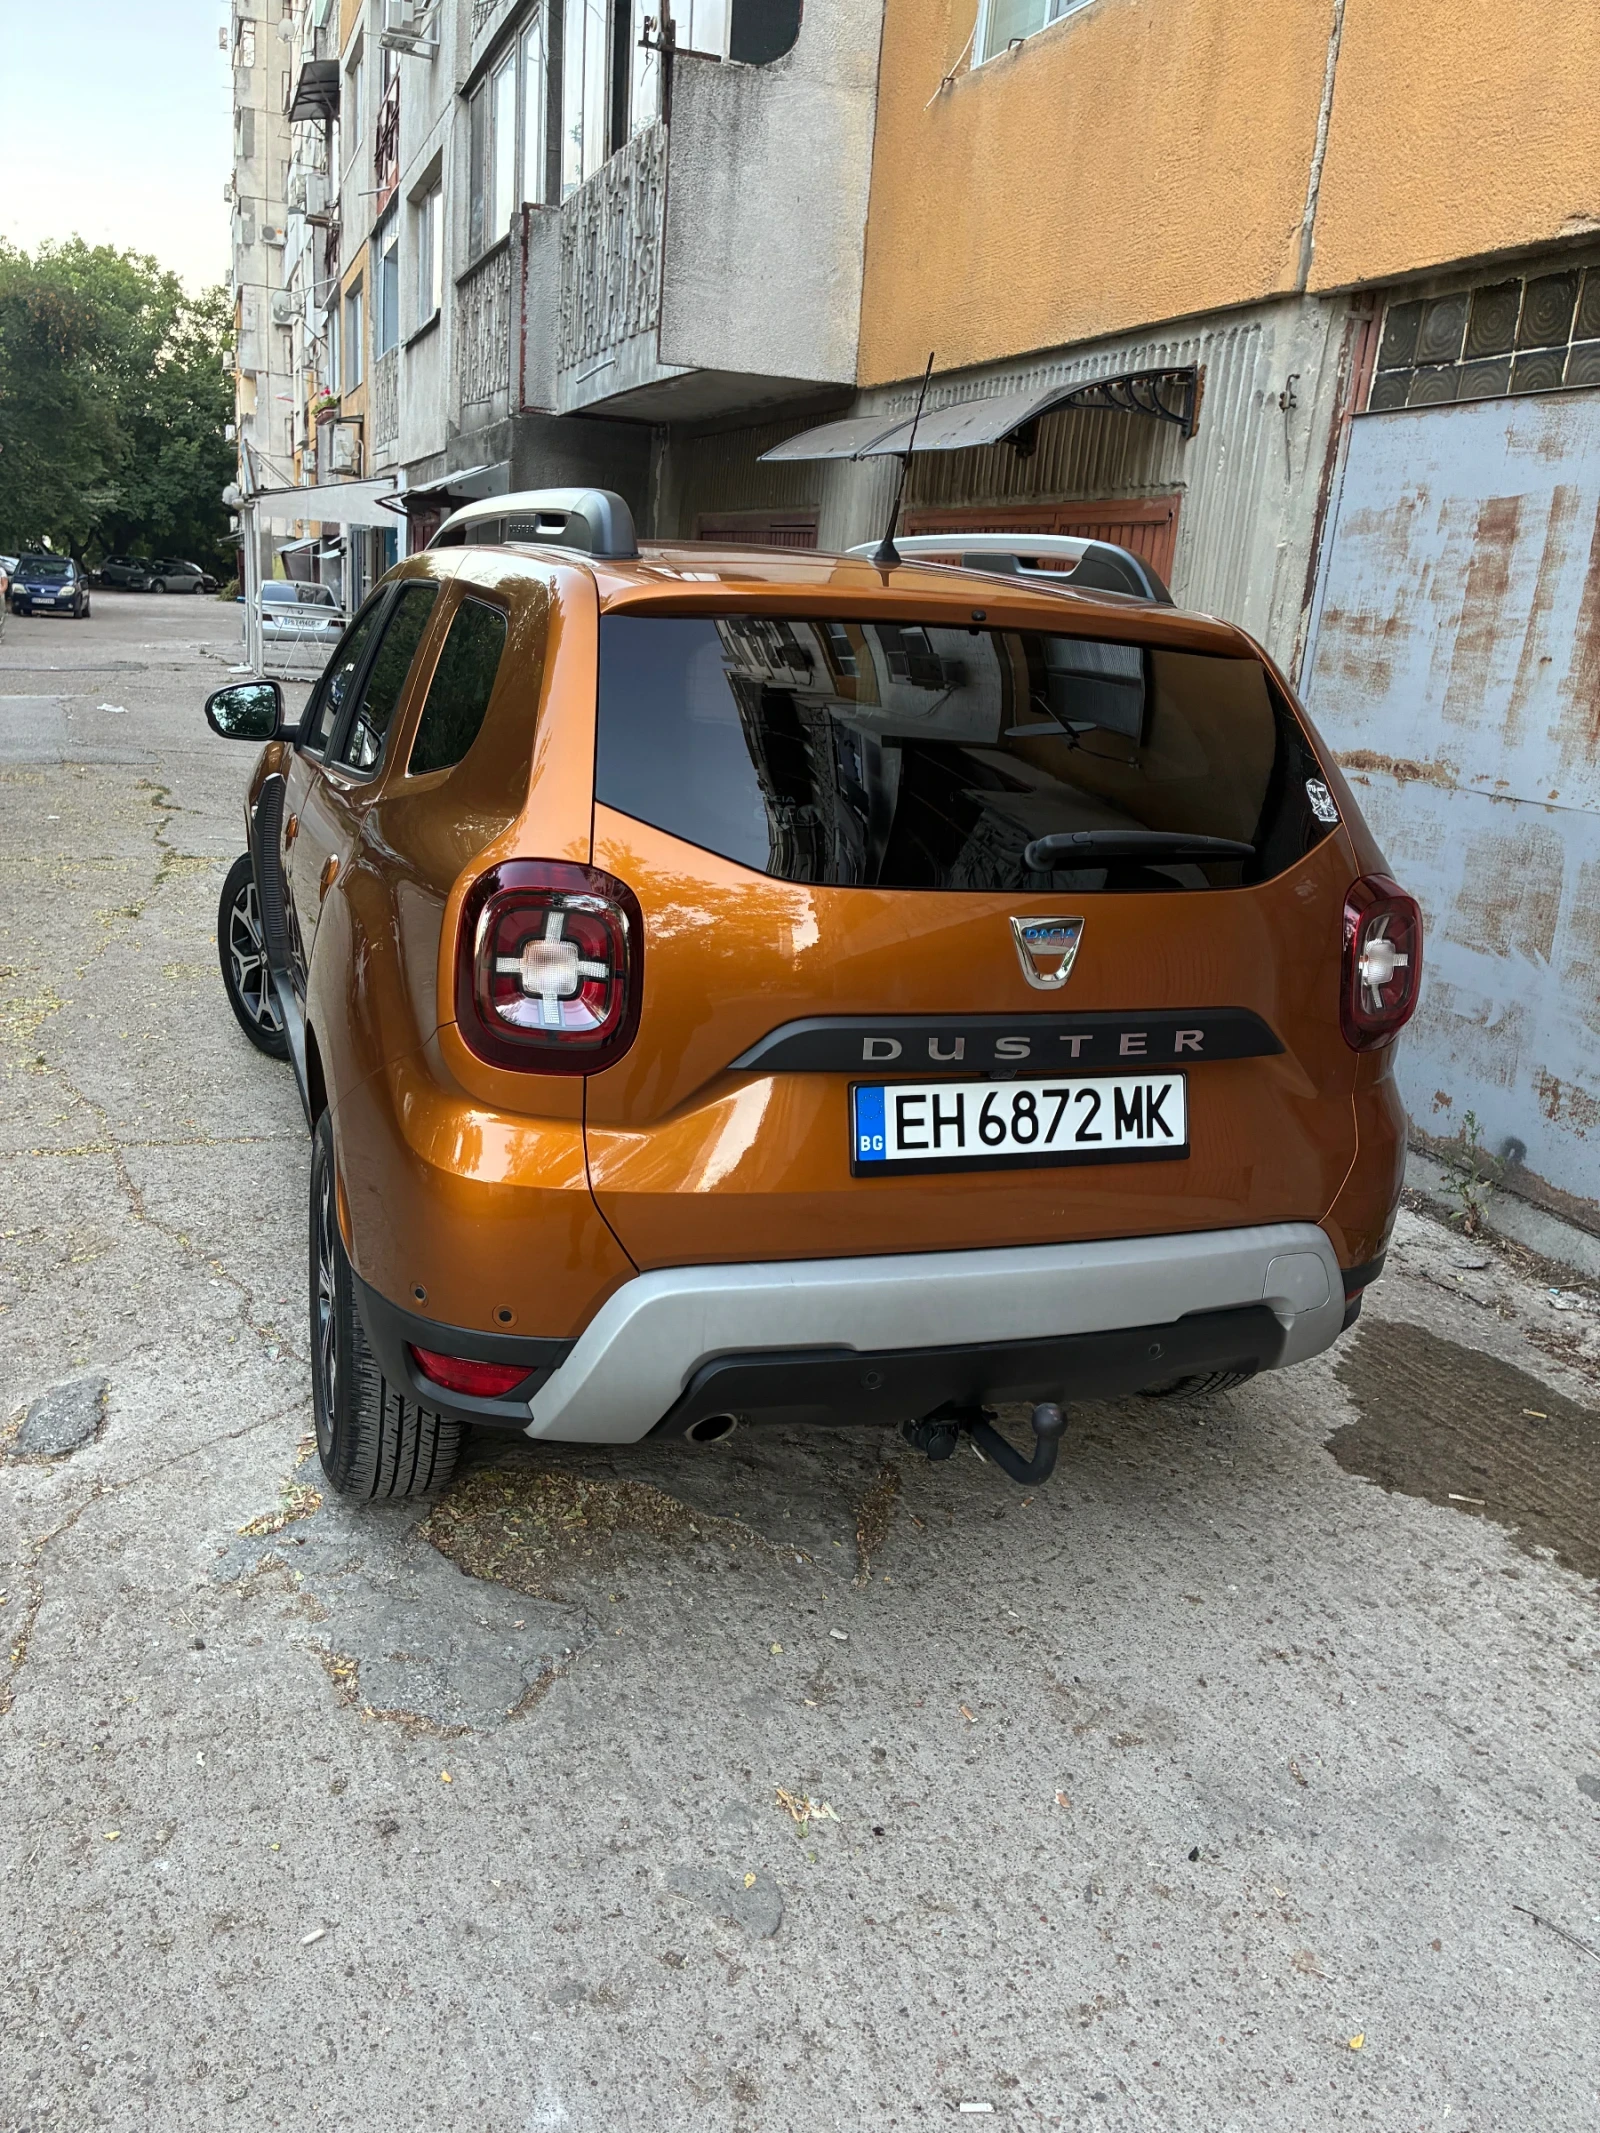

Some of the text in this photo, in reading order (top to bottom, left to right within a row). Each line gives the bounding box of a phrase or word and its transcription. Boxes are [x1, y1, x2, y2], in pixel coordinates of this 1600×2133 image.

[1026, 928, 1075, 939] DACIA
[862, 1029, 1204, 1061] DUSTER
[896, 1084, 1174, 1150] EH 6872 MK
[860, 1135, 883, 1151] BG
